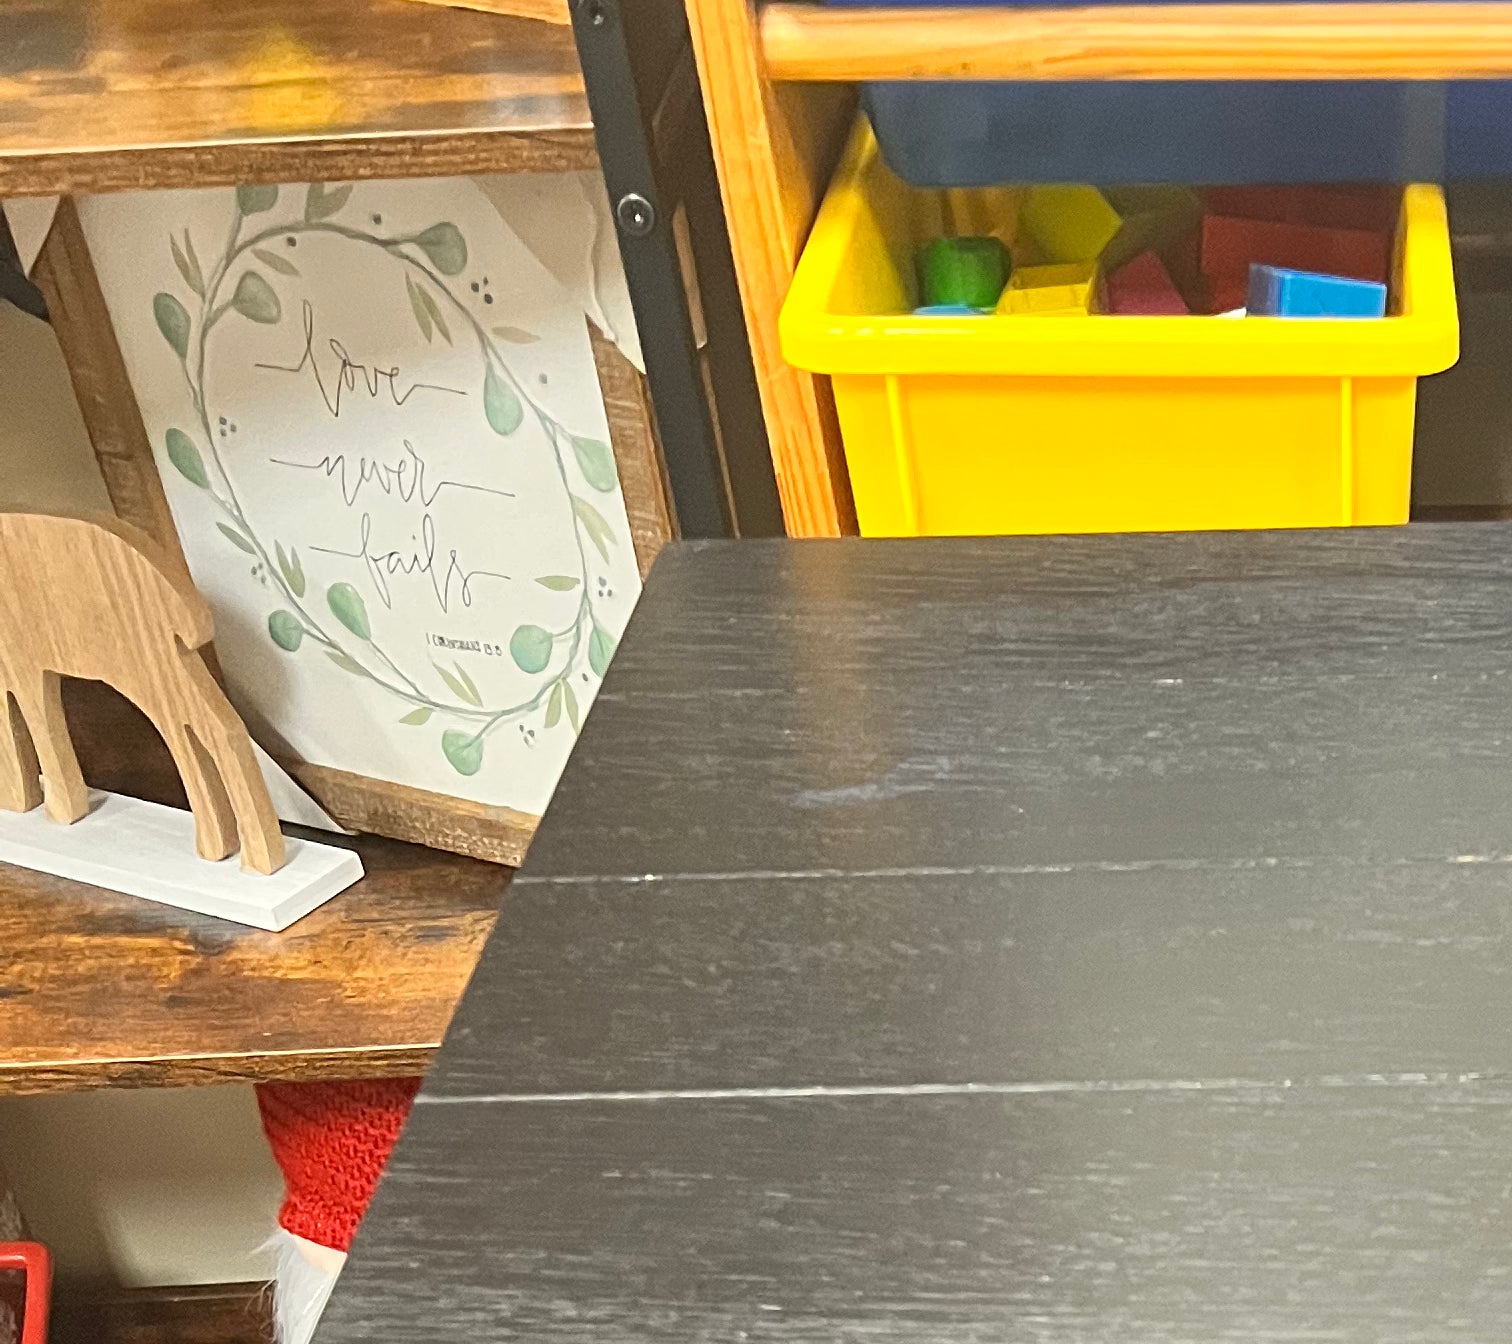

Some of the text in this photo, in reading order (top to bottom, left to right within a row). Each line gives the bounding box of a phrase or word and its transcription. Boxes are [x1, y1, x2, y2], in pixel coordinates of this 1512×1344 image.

[254, 299, 468, 418] love
[269, 438, 516, 507] never
[308, 511, 512, 615] fails
